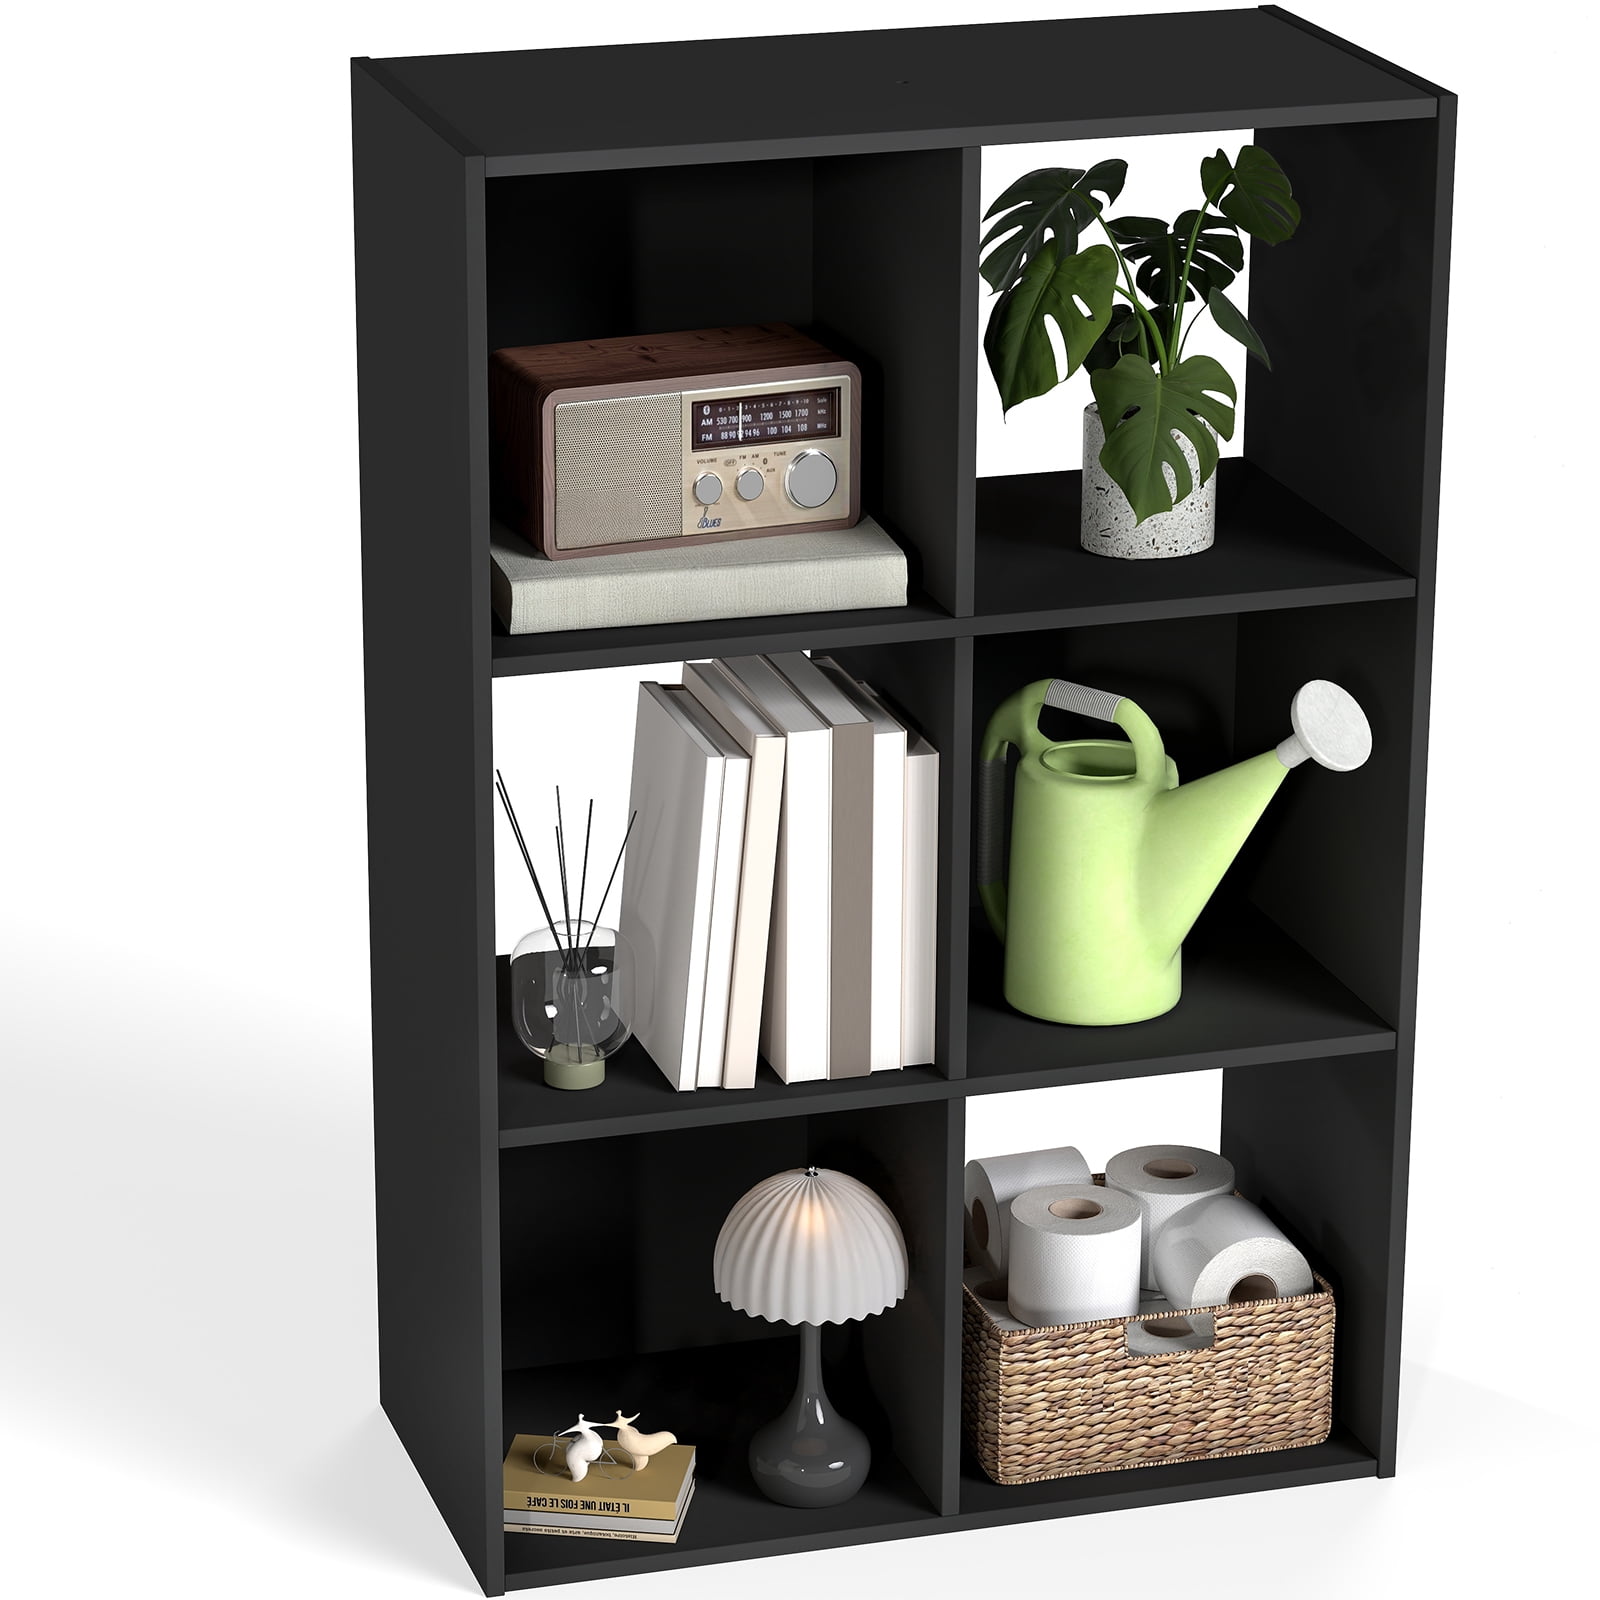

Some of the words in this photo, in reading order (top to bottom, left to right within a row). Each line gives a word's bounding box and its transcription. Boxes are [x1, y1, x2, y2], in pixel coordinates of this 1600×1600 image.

[701, 418, 713, 426] AM
[716, 416, 728, 426] 530
[728, 415, 738, 424] 700
[760, 412, 774, 421] 1200
[779, 410, 792, 419] 1500
[795, 408, 809, 417] 1700
[702, 433, 713, 441] FM
[721, 431, 728, 440] 88
[729, 430, 736, 439] 90
[745, 429, 752, 437] 94
[752, 428, 760, 437] 96
[767, 426, 778, 435] 100
[781, 425, 792, 434] 104
[797, 423, 808, 432] 108
[702, 517, 722, 528] BLUES
[527, 1496, 547, 1508] CAFÉ
[549, 1498, 559, 1508] LE
[561, 1499, 578, 1509] FOIS
[580, 1500, 596, 1510] UNE
[598, 1501, 620, 1514] ÉTAIT
[622, 1503, 630, 1513] IL
